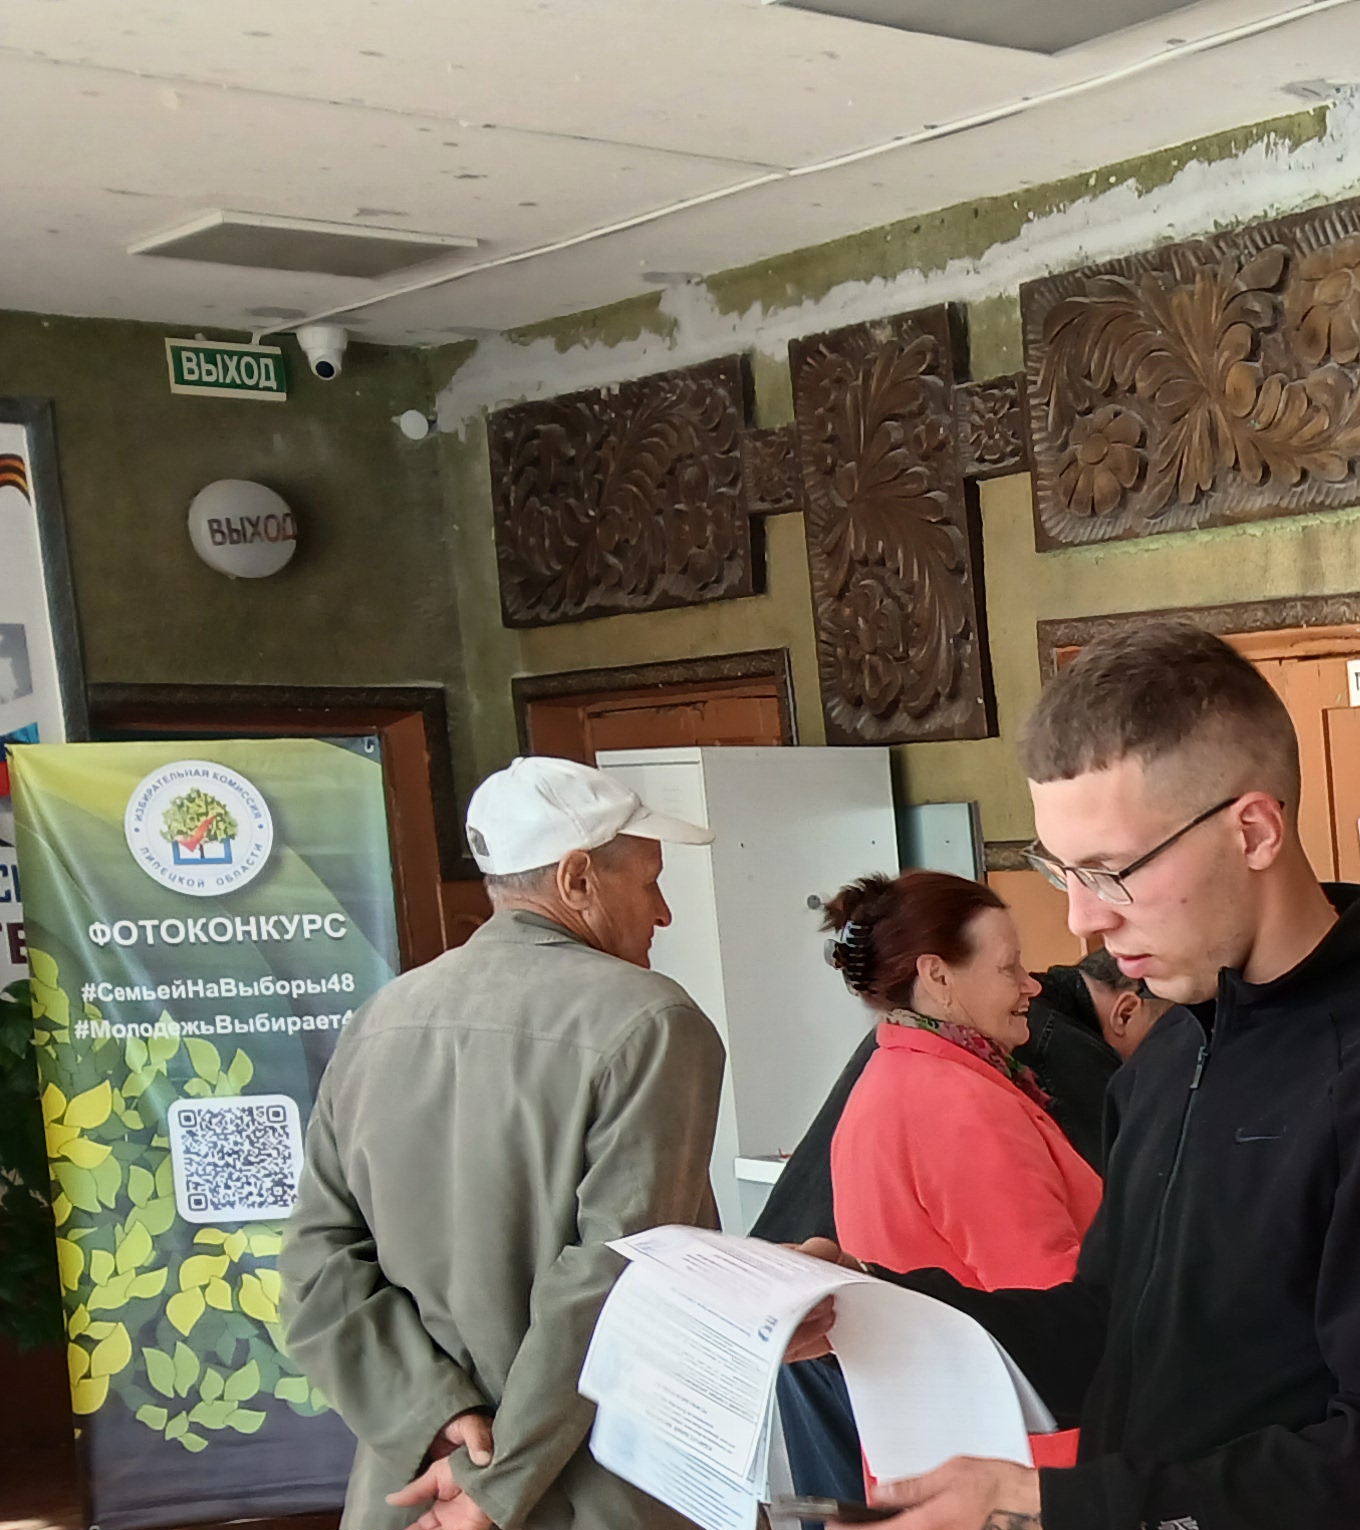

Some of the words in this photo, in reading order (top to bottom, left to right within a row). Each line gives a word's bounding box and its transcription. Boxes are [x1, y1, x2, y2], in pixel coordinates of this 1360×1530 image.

[181, 351, 277, 389] ВЫХОД
[207, 512, 298, 546] ВЫХОД
[134, 768, 210, 822] ИЗБИРАТЕЛЬНАЯ
[212, 772, 263, 819] КОМИССИЯ
[216, 843, 263, 886] ОБЛАСТИ
[88, 913, 348, 947] ФОТОКОНКУРС
[81, 973, 355, 1003] #СемьейНаВыборы48
